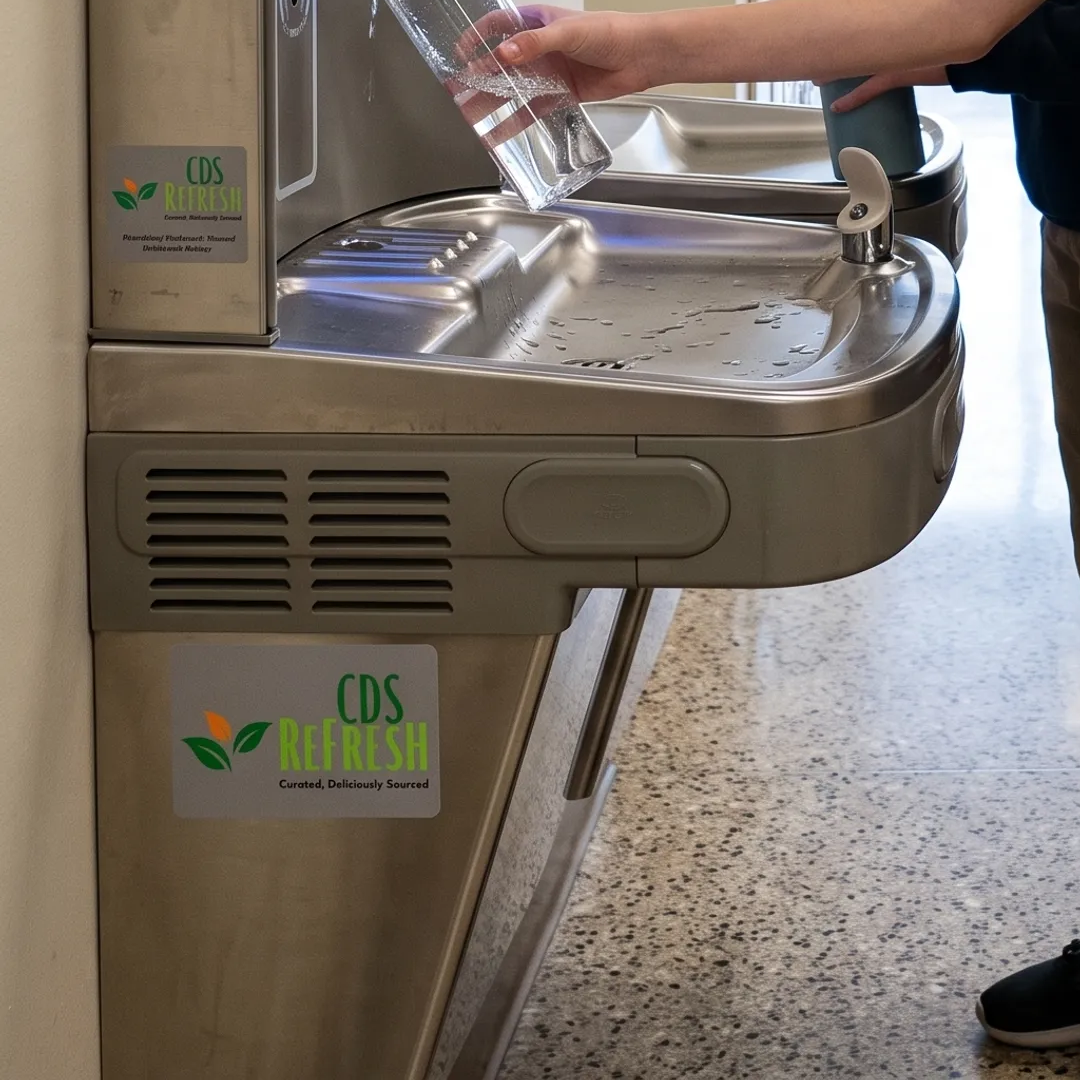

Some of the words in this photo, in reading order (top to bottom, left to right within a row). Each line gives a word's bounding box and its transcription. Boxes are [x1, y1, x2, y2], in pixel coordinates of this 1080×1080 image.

[186, 156, 224, 185] CDS
[337, 673, 404, 725] CDS
[279, 779, 325, 790] Curated,
[328, 779, 383, 791] Deliciously
[386, 779, 429, 789] Sourced
